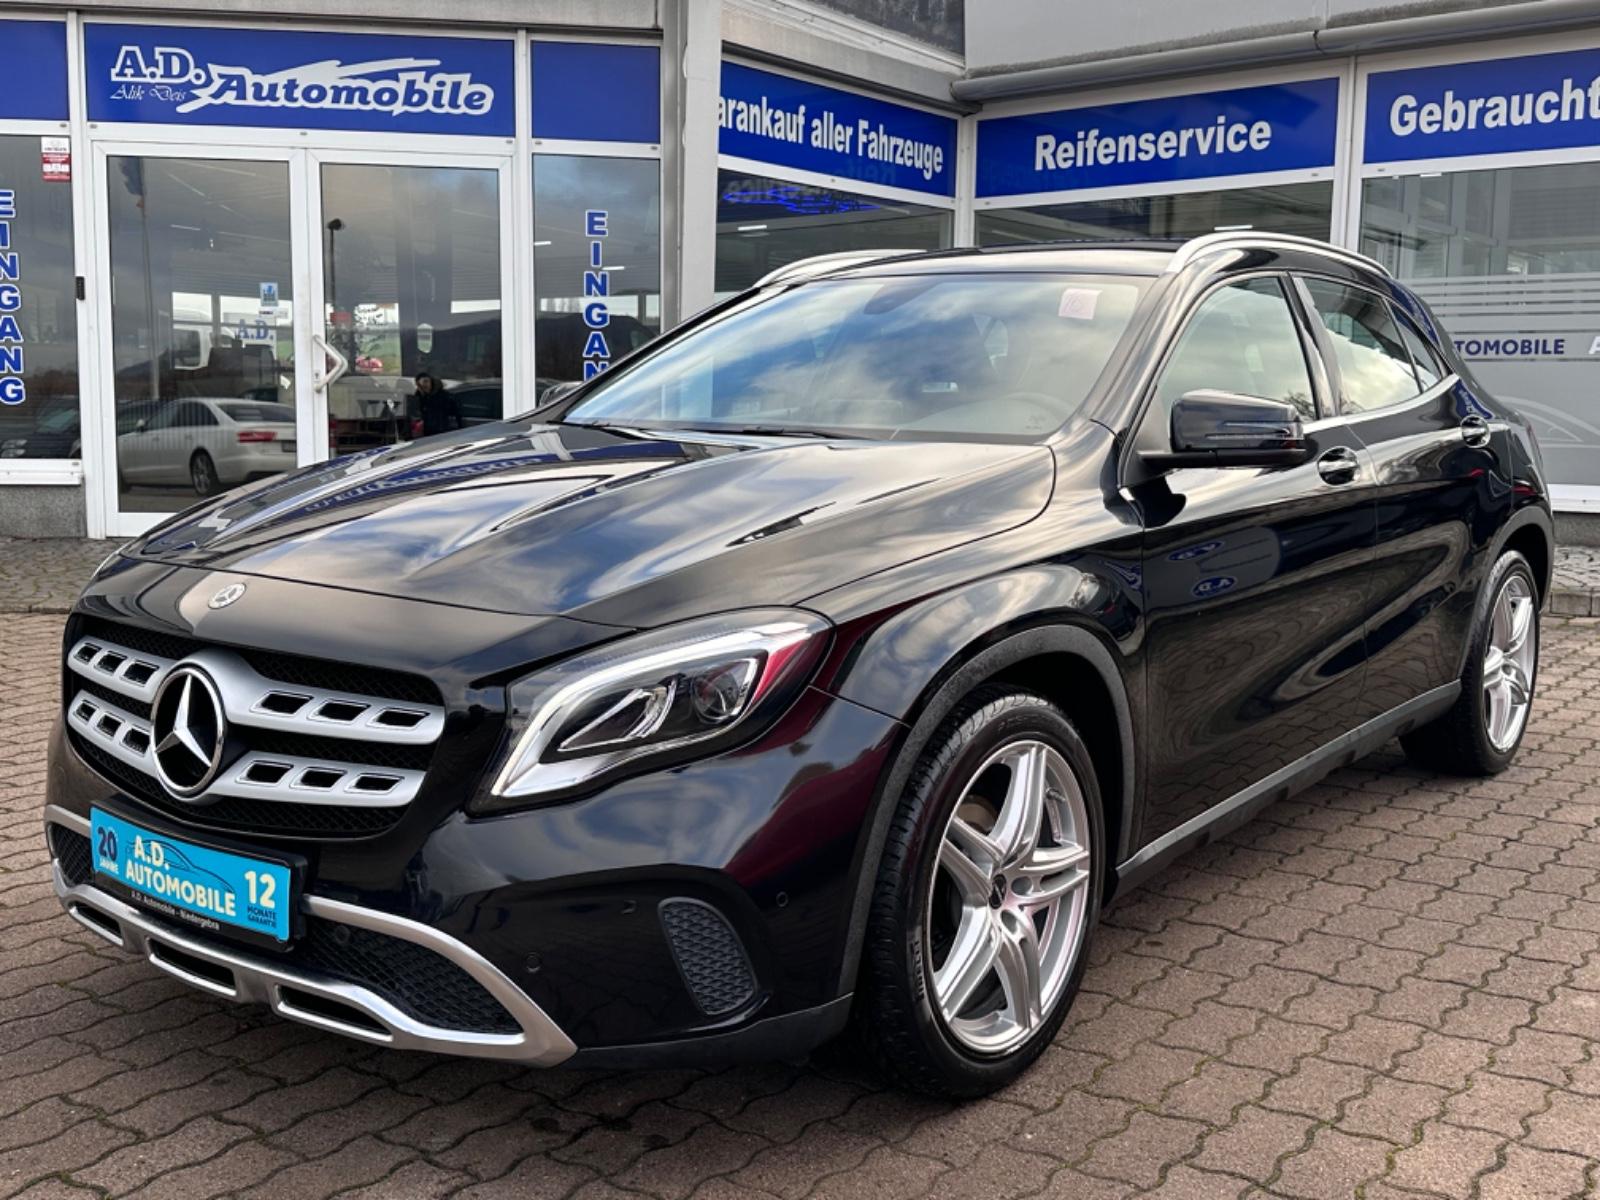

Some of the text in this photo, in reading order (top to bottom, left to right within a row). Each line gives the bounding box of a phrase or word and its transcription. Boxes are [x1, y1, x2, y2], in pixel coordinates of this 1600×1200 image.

[111, 46, 494, 115] A.D. Automobile
[811, 111, 853, 154] aller
[858, 119, 944, 181] Fahrzeuge
[1034, 115, 1272, 171] Reifenservice
[97, 825, 118, 862] 20
[133, 834, 171, 871] A.D.
[125, 858, 237, 917] AUTOMOBILE
[244, 870, 276, 910] 12
